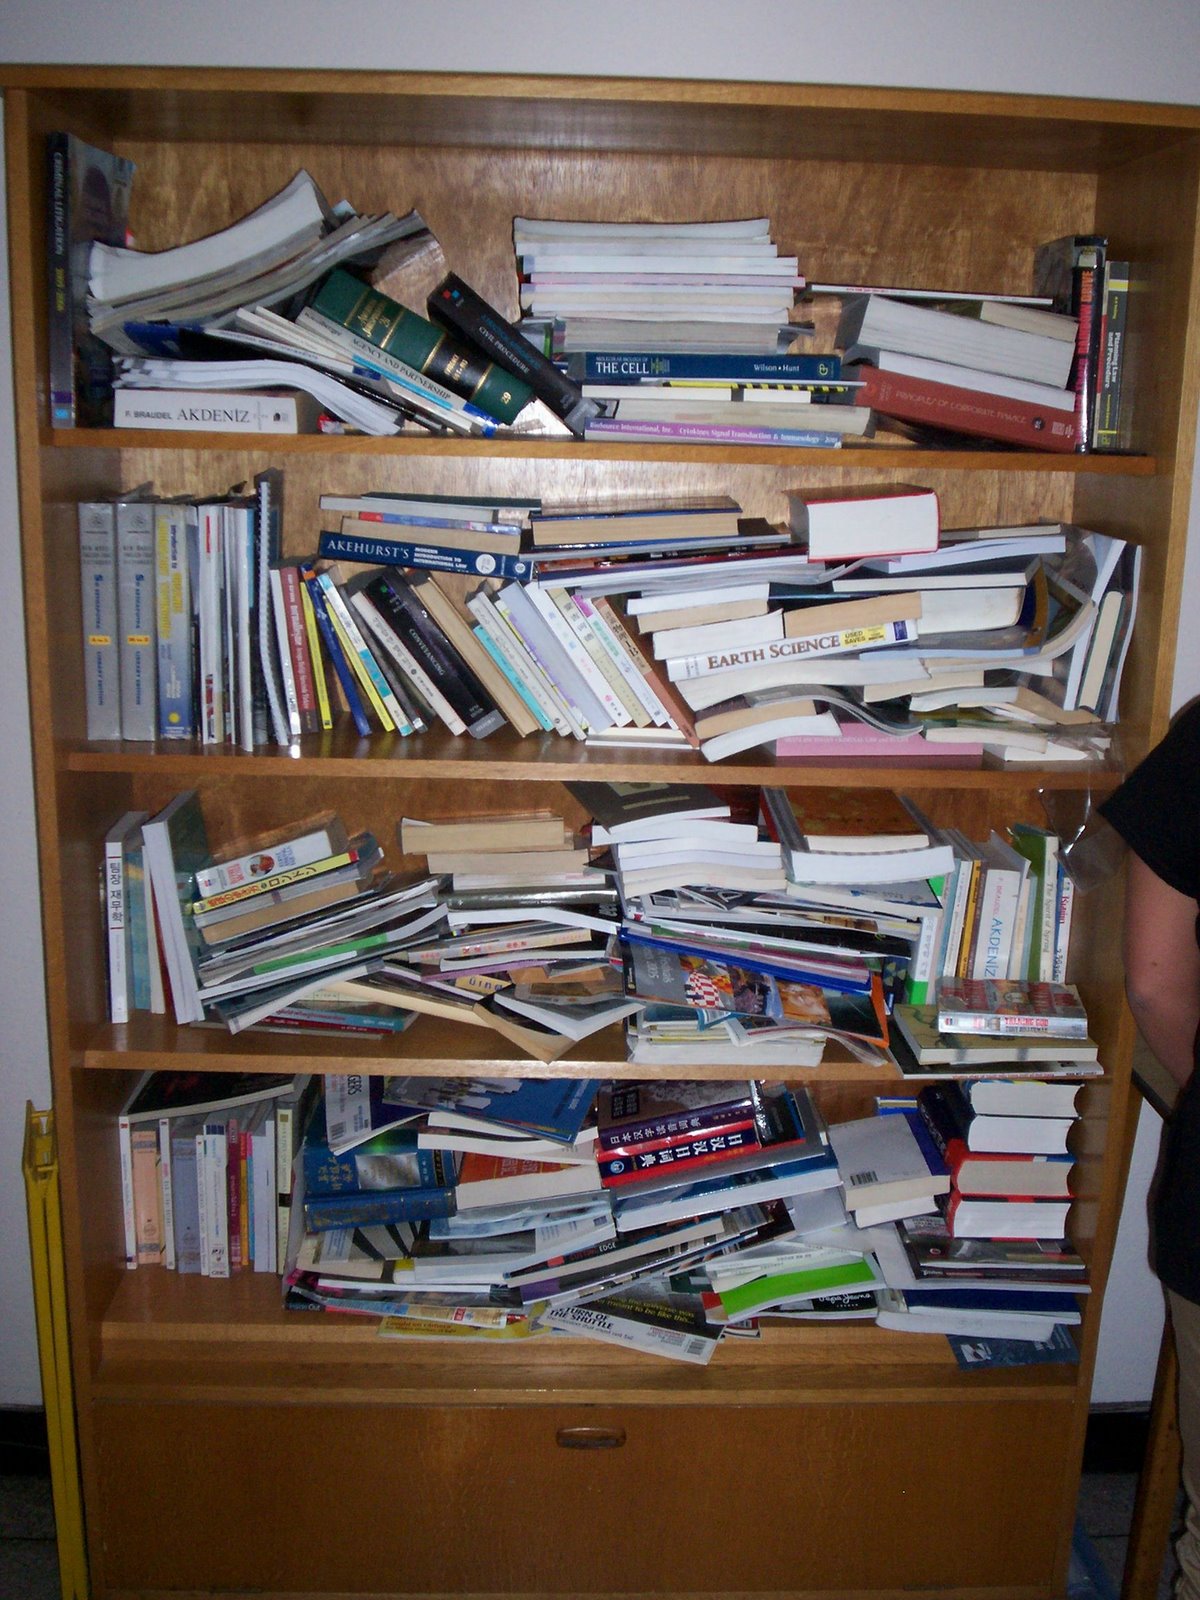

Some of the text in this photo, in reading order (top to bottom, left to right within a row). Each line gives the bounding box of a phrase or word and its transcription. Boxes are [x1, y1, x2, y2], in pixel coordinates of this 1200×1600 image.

[53, 151, 63, 199] CRIMINAL
[54, 201, 63, 255] LITIGATION
[1080, 270, 1093, 302] DRIVE
[476, 325, 497, 343] CIVIL
[492, 339, 532, 374] PROCEDURE
[1110, 331, 1120, 383] Planning Law
[350, 337, 381, 359] AGENCY
[383, 356, 400, 370] AND
[398, 364, 452, 402] PARTNERSHIP
[596, 362, 650, 374] THE CELL
[754, 364, 800, 372] Wilson Hunt
[1103, 347, 1113, 389] Procedure
[134, 411, 172, 420] BRAUDEL
[176, 406, 251, 423] AKDENİZ
[169, 524, 178, 560] Introduction
[327, 538, 410, 559] AKEHURST'S
[413, 557, 454, 567] INTERNATIONAL
[844, 630, 863, 638] USED
[844, 635, 866, 645] SAVES
[404, 626, 449, 677] CONVEYANCING
[706, 646, 765, 670] EARTH
[768, 631, 841, 659] SCIENCE
[267, 864, 317, 887] ロンドン
[1045, 881, 1053, 896] The
[984, 917, 1003, 978] AKDENİZ
[638, 1131, 743, 1168] 日汉汉日词典
[597, 1239, 617, 1254] EDGE
[307, 1303, 320, 1311] Out
[594, 1313, 608, 1321] OF
[608, 1298, 633, 1310] meant
[644, 1307, 654, 1315] be
[656, 1309, 672, 1319] like
[550, 1308, 613, 1330] THE SHUTTLE
